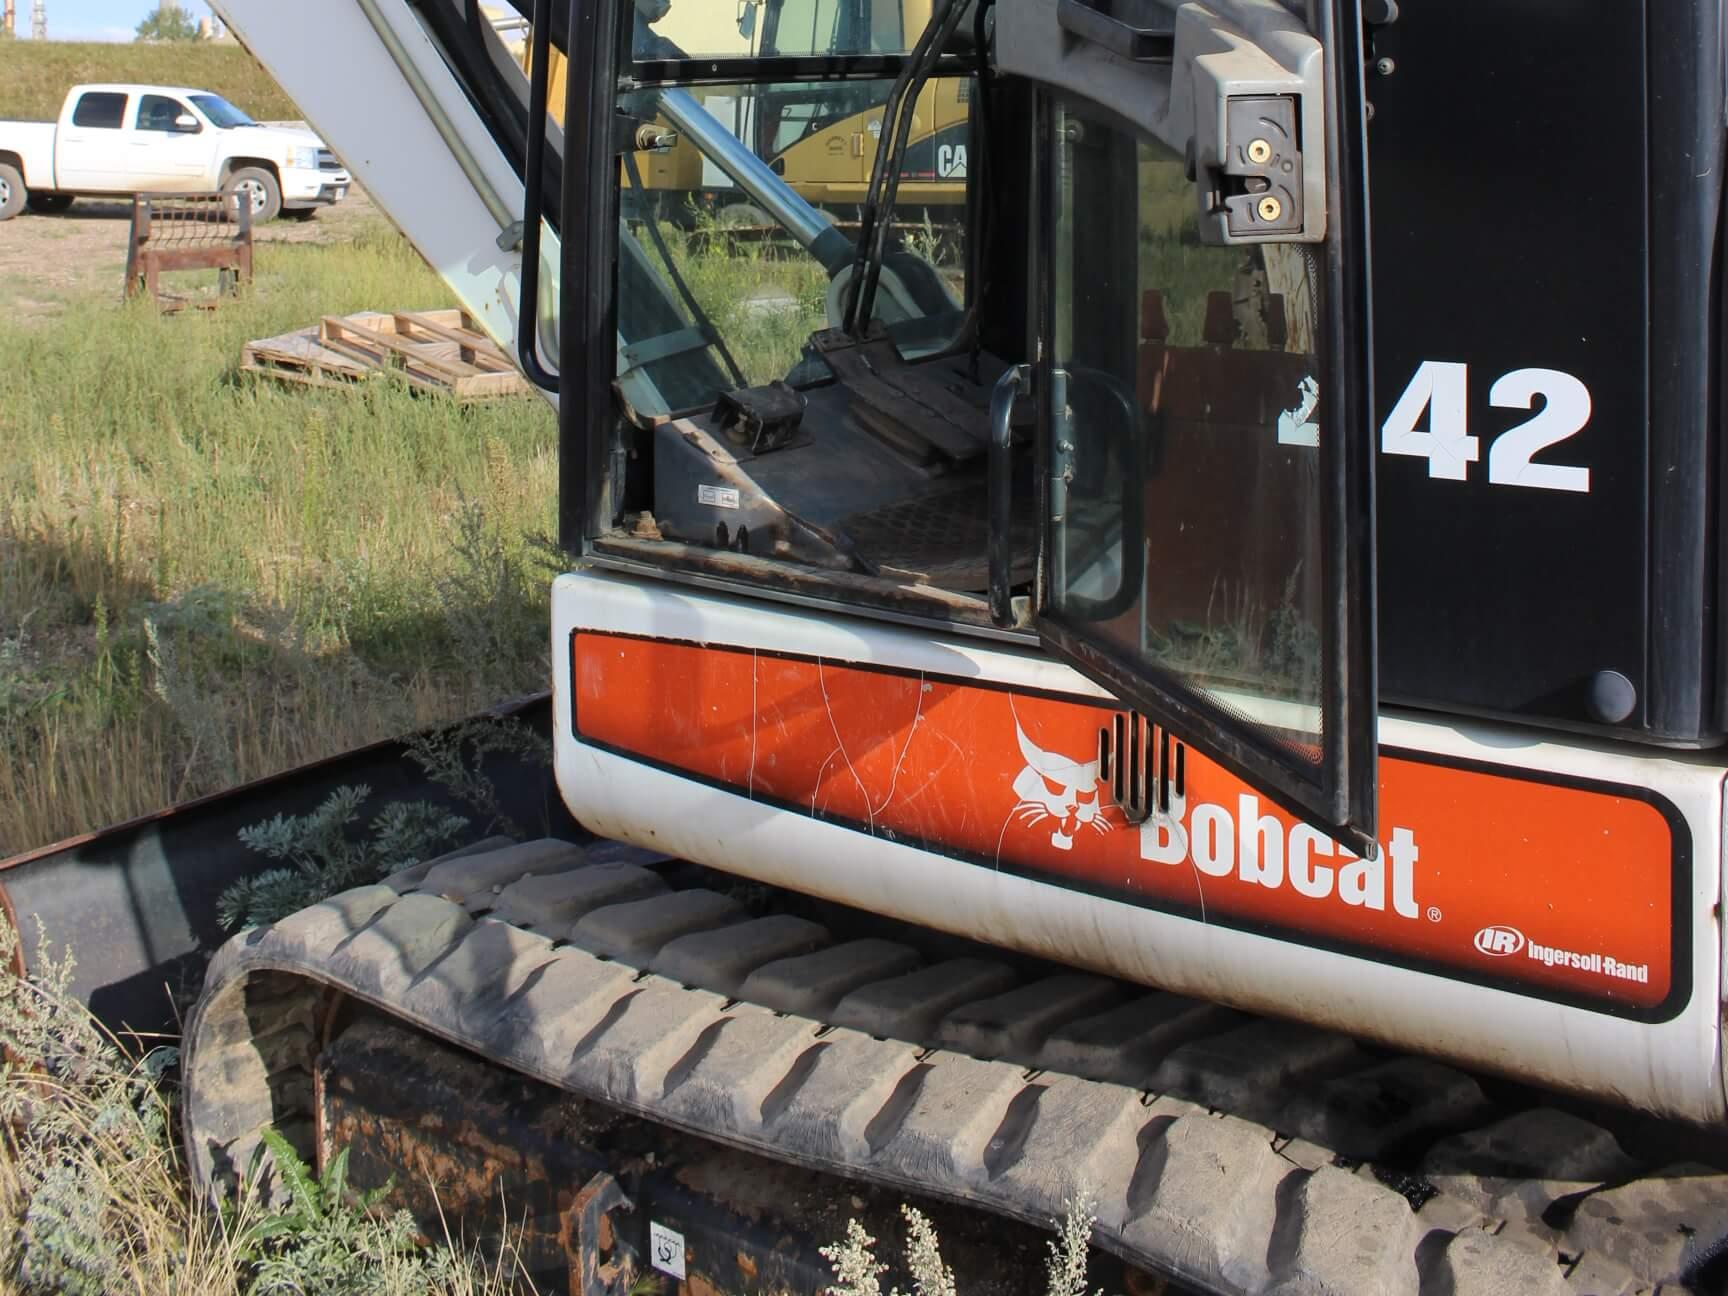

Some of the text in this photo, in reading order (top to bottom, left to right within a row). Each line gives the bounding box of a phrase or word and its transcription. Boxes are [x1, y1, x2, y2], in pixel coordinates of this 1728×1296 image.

[937, 144, 968, 178] CA
[1139, 780, 1419, 920] Bobcat
[1527, 938, 1649, 984] Ingersoll-Rand
